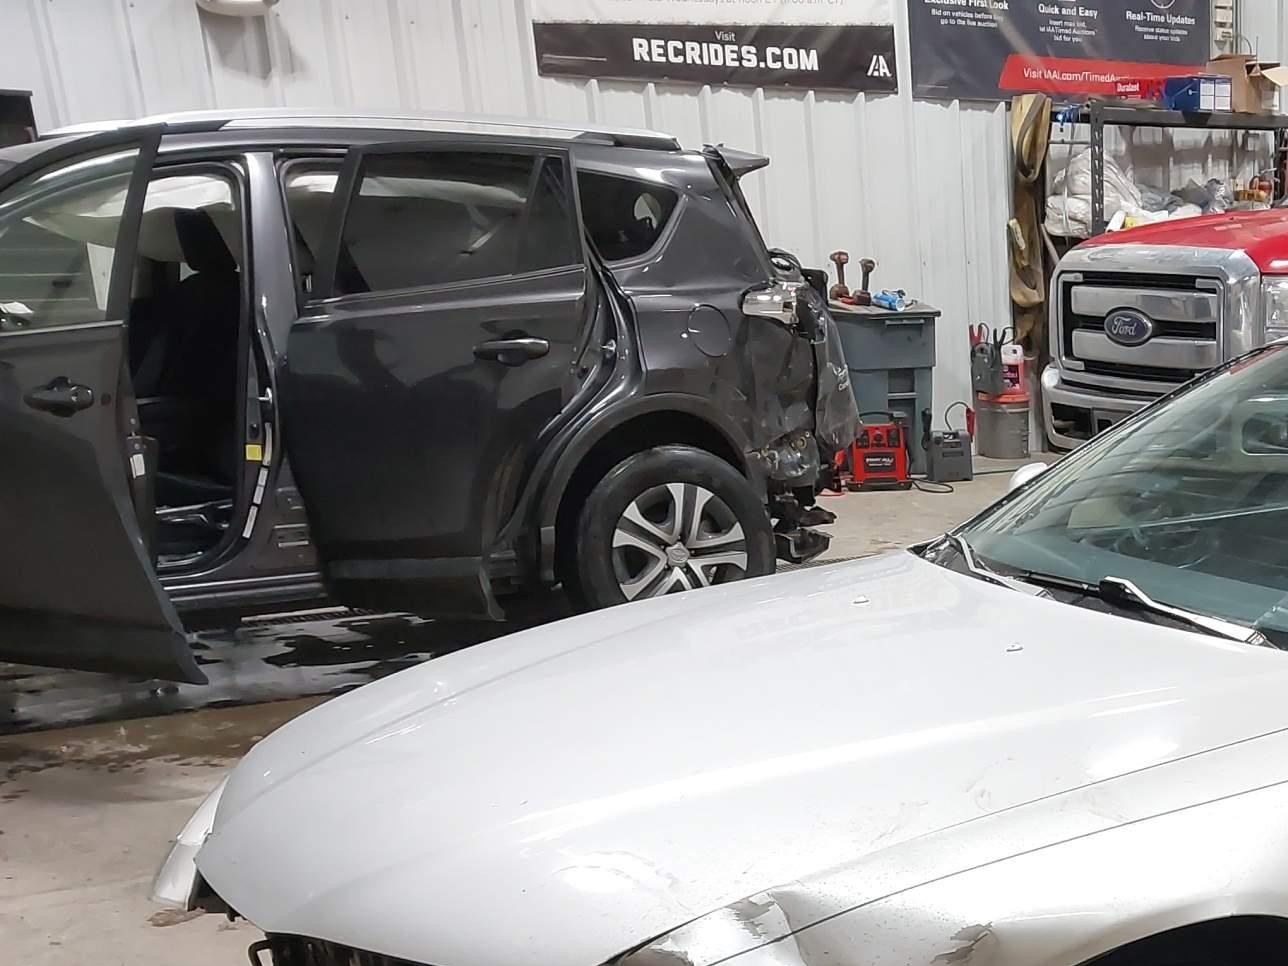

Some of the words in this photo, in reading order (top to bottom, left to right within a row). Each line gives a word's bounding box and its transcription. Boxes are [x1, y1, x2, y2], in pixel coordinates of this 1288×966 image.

[989, 0, 1009, 10] Look
[1038, 4, 1059, 15] Quick
[1061, 7, 1077, 16] and
[1079, 7, 1098, 20] Easy
[1125, 10, 1166, 23] Real-Time
[1166, 13, 1196, 26] Updates
[714, 30, 736, 42] Visit
[632, 37, 819, 72] RECRIDES.COM
[1023, 67, 1043, 79] Visit
[1111, 316, 1137, 335] Ford
